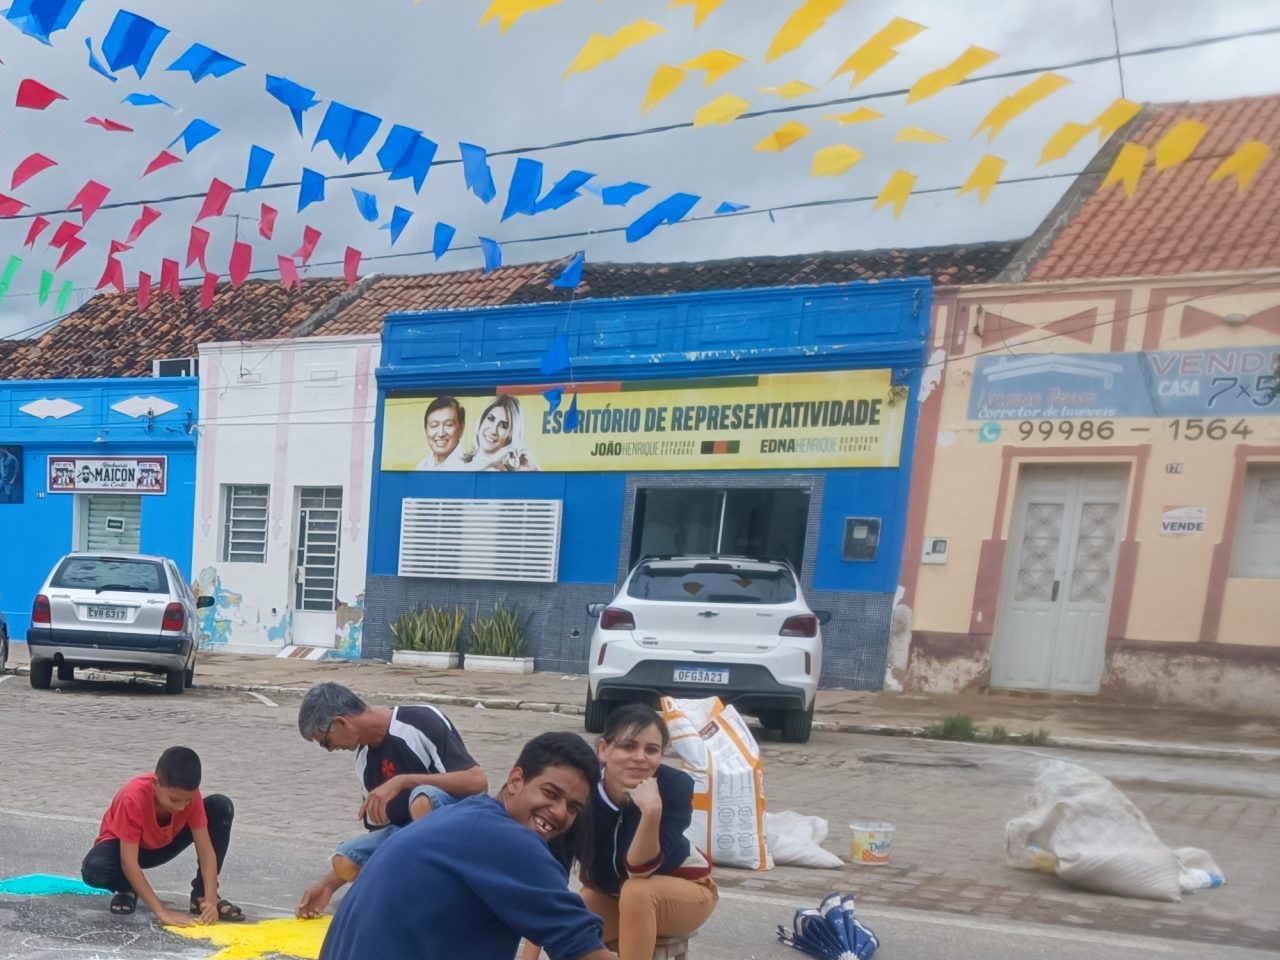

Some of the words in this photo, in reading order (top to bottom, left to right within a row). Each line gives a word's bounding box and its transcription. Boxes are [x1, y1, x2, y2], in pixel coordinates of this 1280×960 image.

[1158, 379, 1201, 397] CASA
[644, 406, 668, 432] DE
[670, 398, 883, 432] REPRESENTATIVIDADE
[1018, 420, 1115, 442] 99986
[1168, 418, 1254, 441] 1564
[590, 440, 622, 457] JOÃO
[622, 441, 660, 457] HENRIQUE
[760, 438, 796, 454] EDNA
[95, 468, 136, 482] MAICON
[1162, 521, 1204, 531] VENDE
